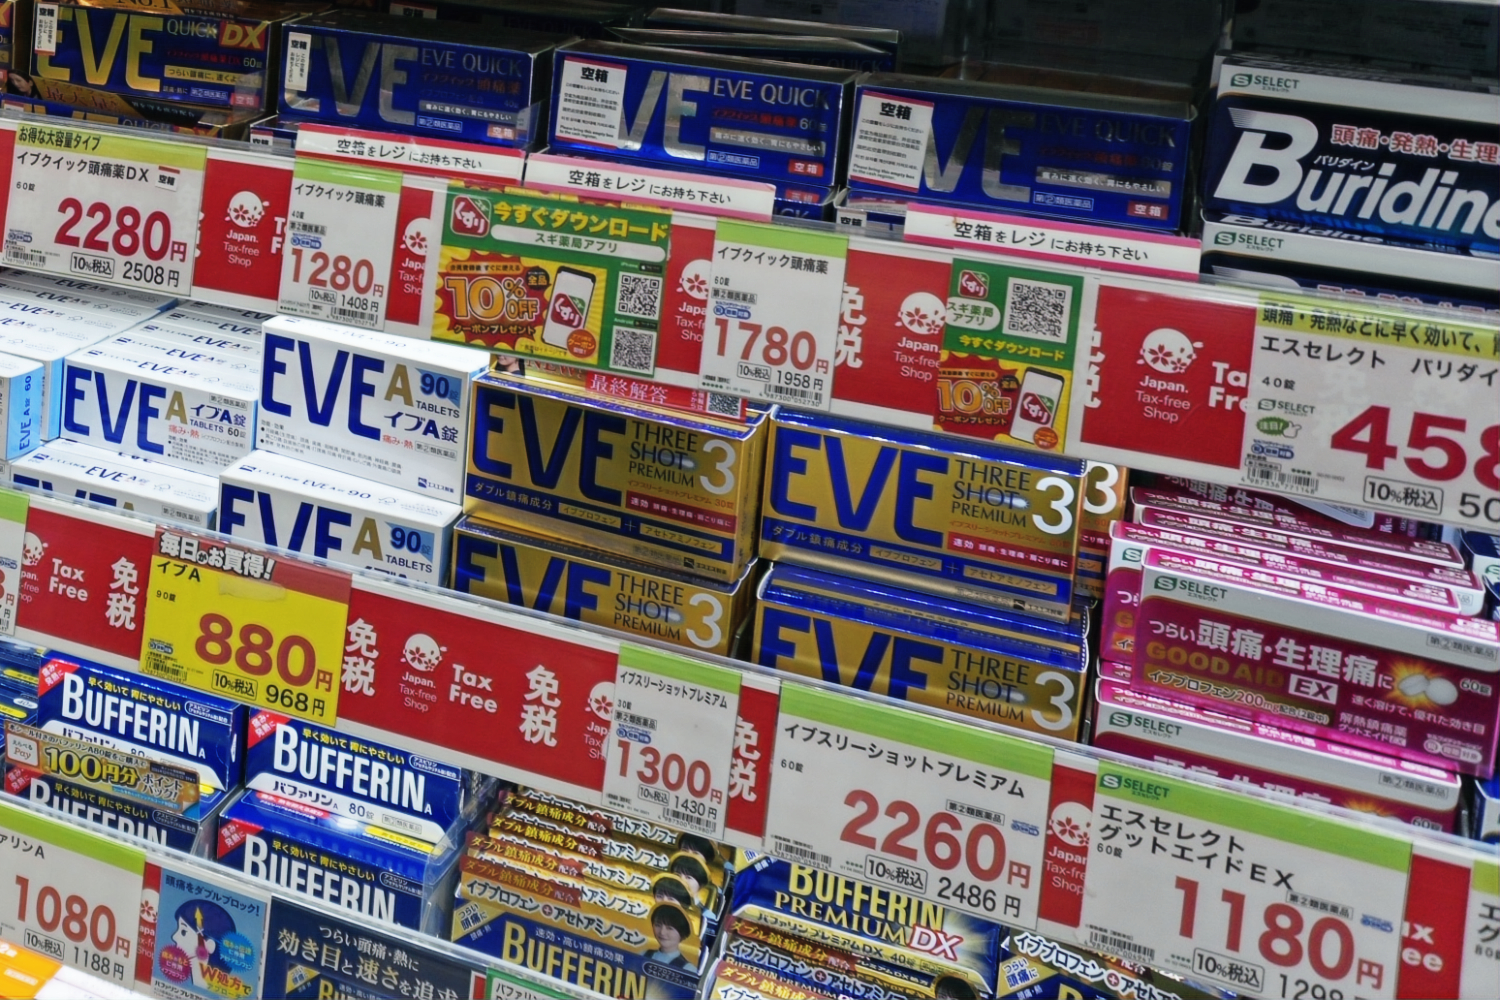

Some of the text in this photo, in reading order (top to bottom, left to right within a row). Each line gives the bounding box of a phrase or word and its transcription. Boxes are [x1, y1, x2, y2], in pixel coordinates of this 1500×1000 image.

[713, 77, 830, 110] EVE QUICK
[1253, 74, 1300, 90] SELECT
[261, 332, 385, 441] EVE
[1140, 376, 1189, 394] Japan.
[416, 400, 460, 418] TABLETS
[1135, 390, 1191, 411] Tax-free
[1143, 406, 1179, 423] Shop
[632, 422, 698, 452] THREE
[629, 461, 694, 488] PREMIUM
[770, 426, 949, 548] EVE
[452, 664, 492, 691] Tax
[449, 686, 497, 713] Free
[275, 722, 426, 811] BUFFERIN
